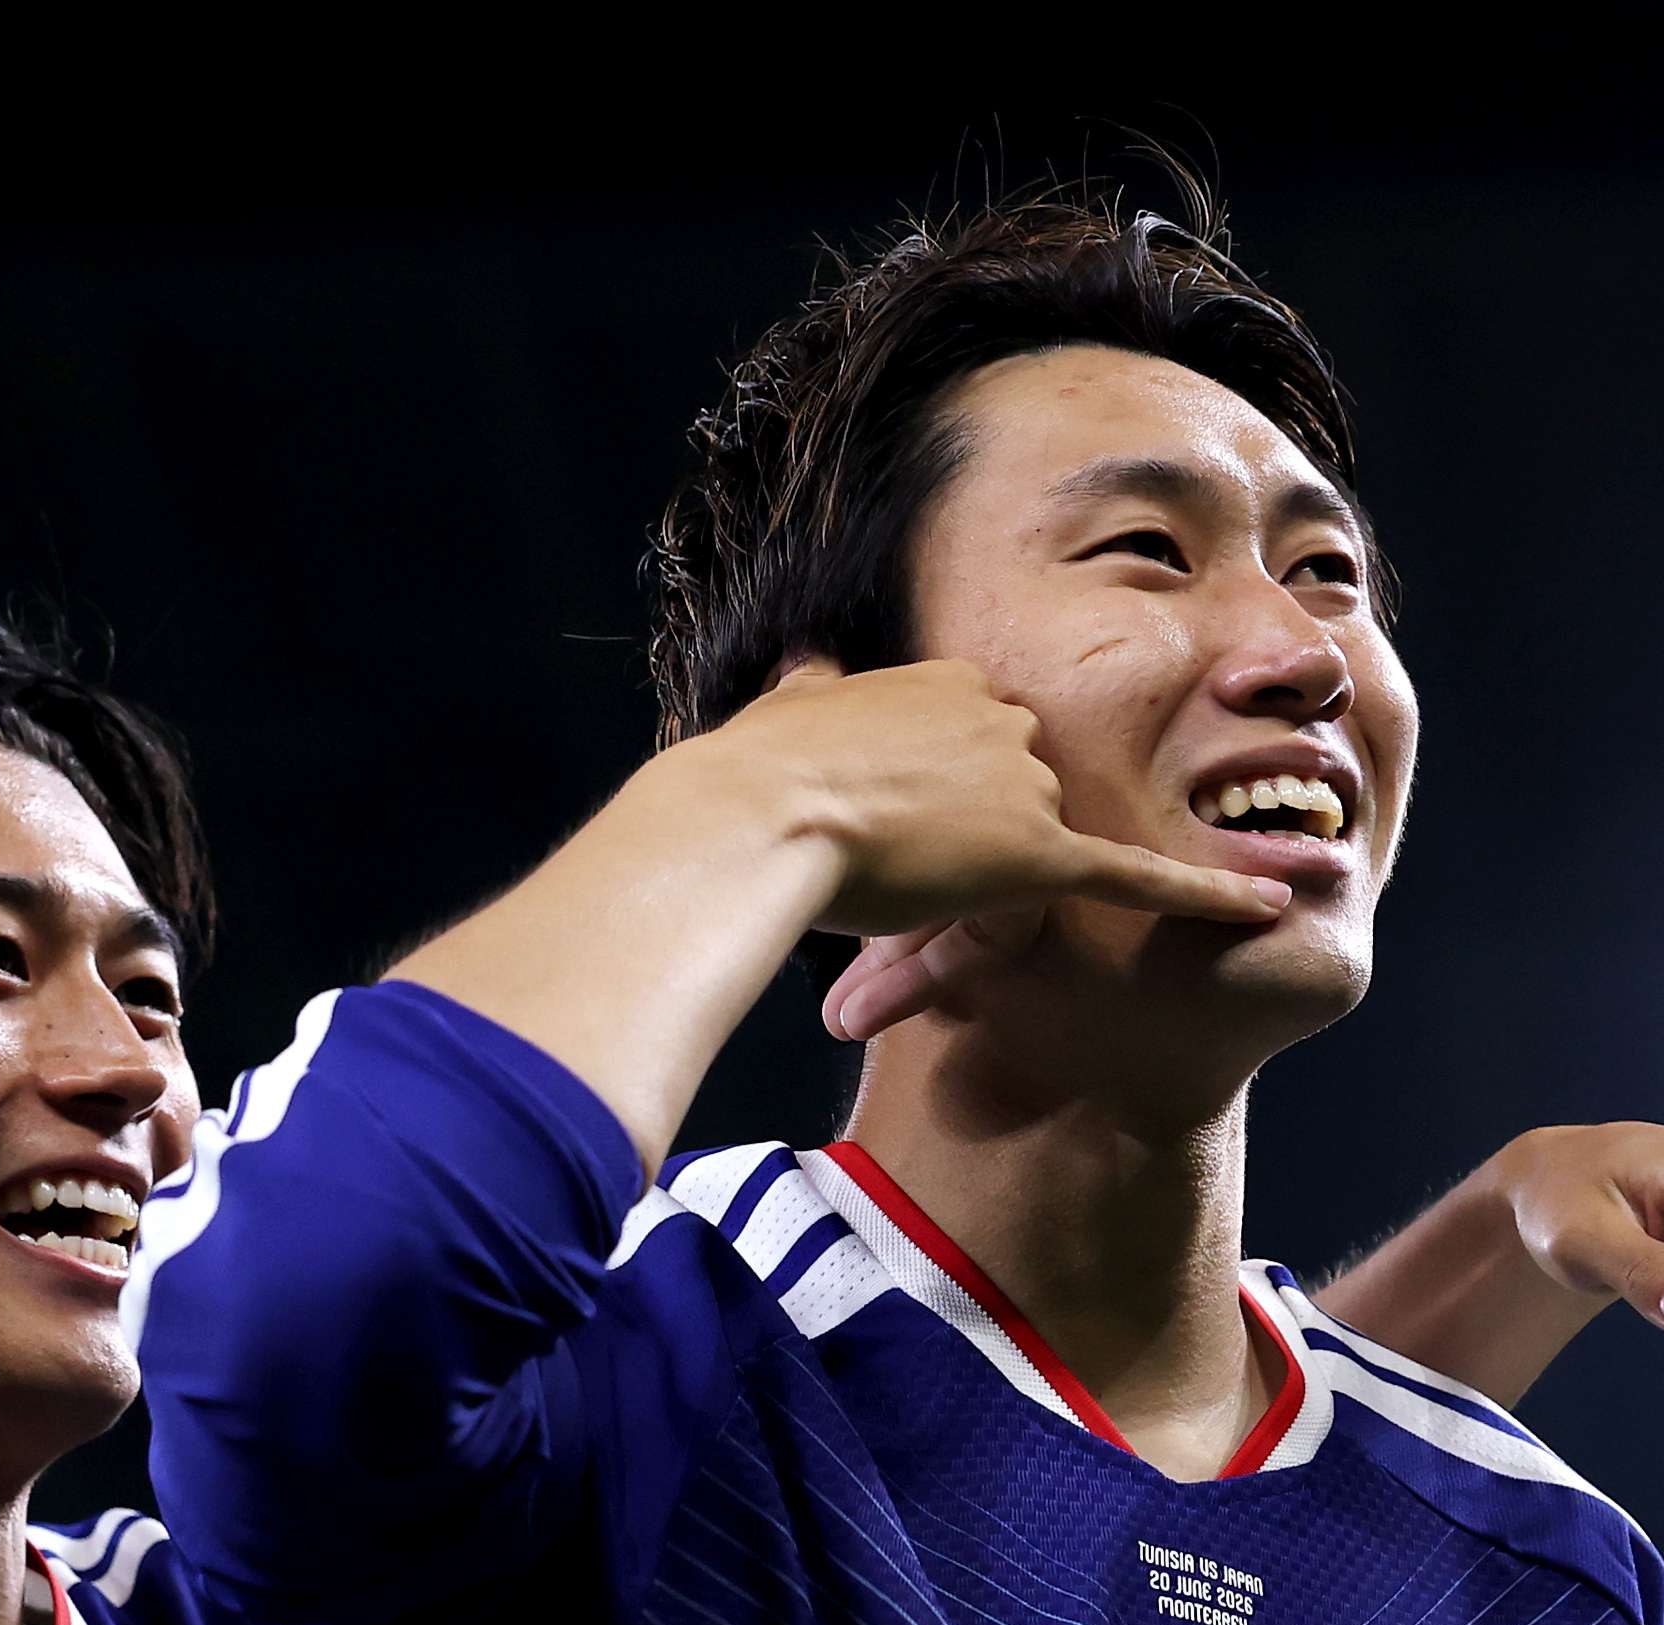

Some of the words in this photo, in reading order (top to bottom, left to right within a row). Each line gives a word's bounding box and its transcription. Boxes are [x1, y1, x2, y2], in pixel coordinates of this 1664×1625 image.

[1138, 1541, 1194, 1573] TUNISIA
[1222, 1565, 1264, 1596] JAPAN
[1150, 1571, 1170, 1592] 20
[1176, 1576, 1212, 1601] JUNE
[1216, 1587, 1253, 1615] 2026
